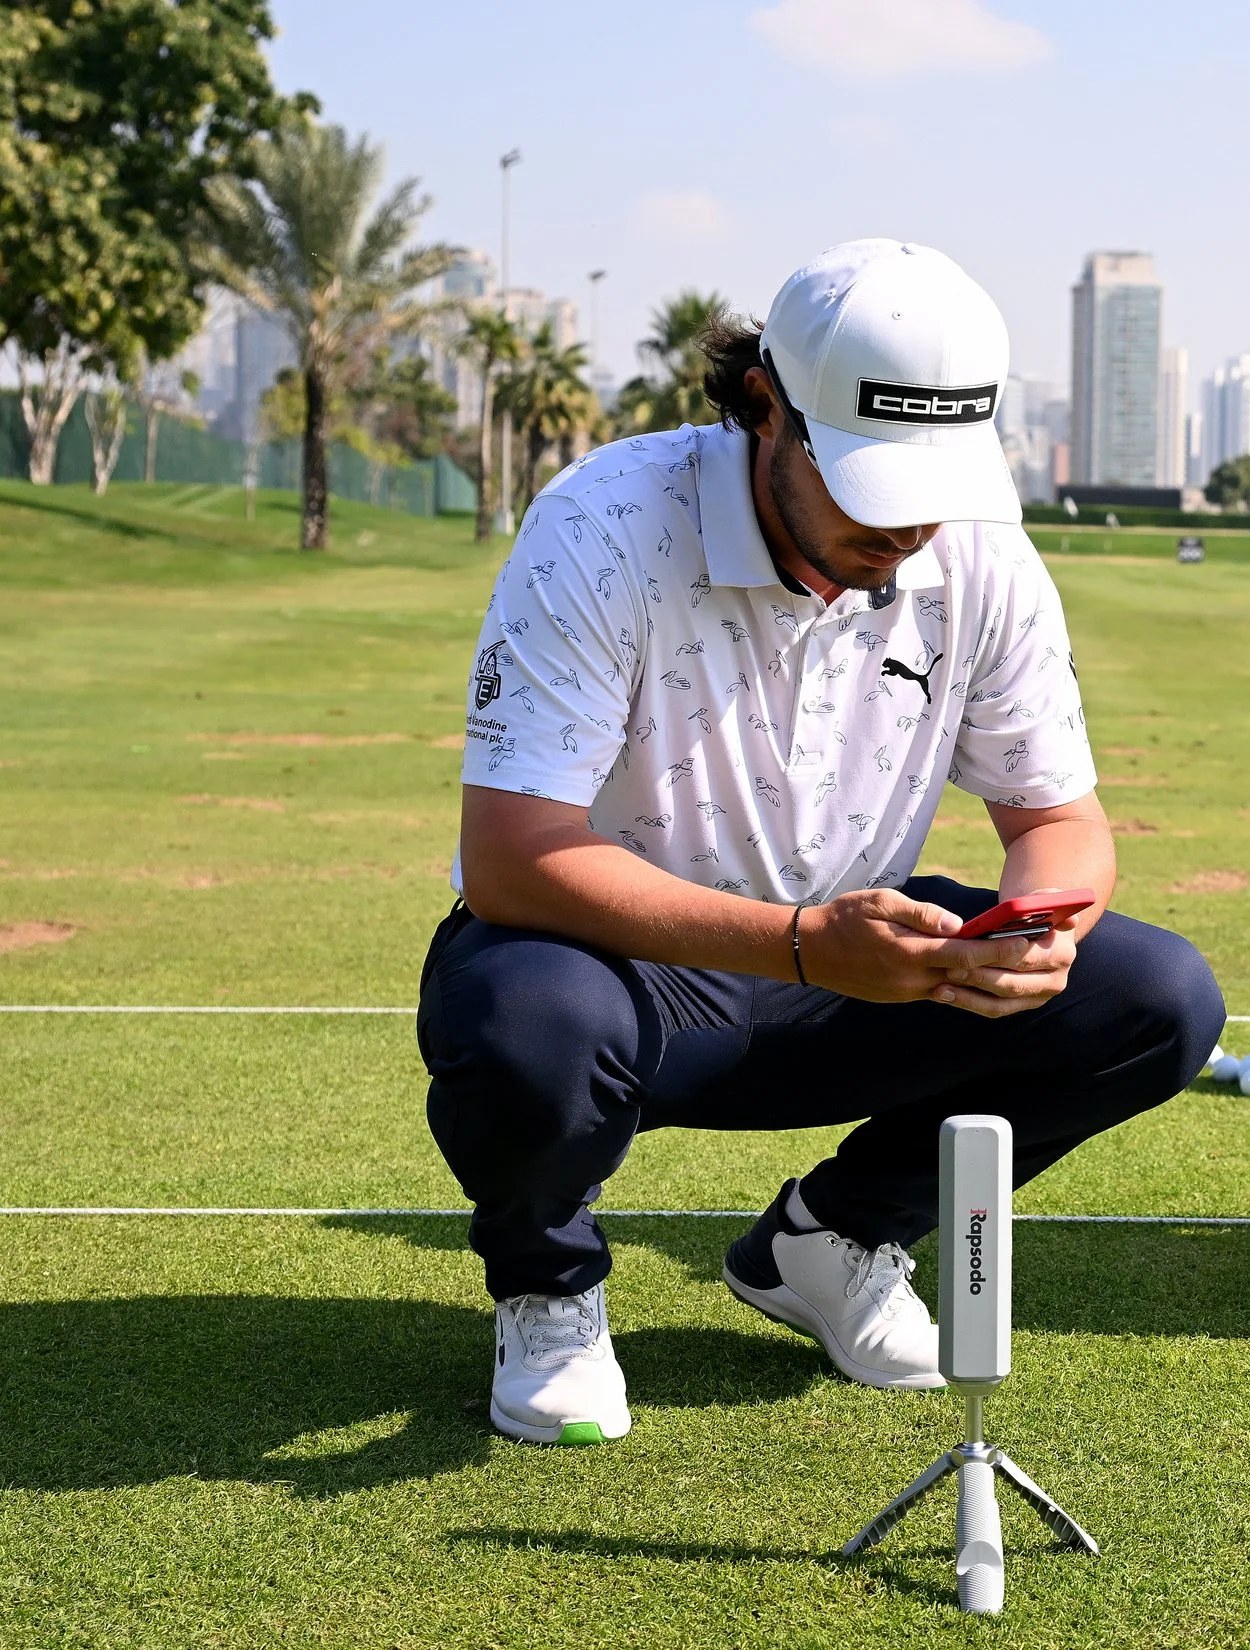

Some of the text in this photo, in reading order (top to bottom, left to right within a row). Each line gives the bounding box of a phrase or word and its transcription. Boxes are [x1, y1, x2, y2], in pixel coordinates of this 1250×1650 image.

[872, 394, 991, 416] cobra
[488, 733, 504, 745] plc
[965, 1209, 988, 1296] Rapsodo
